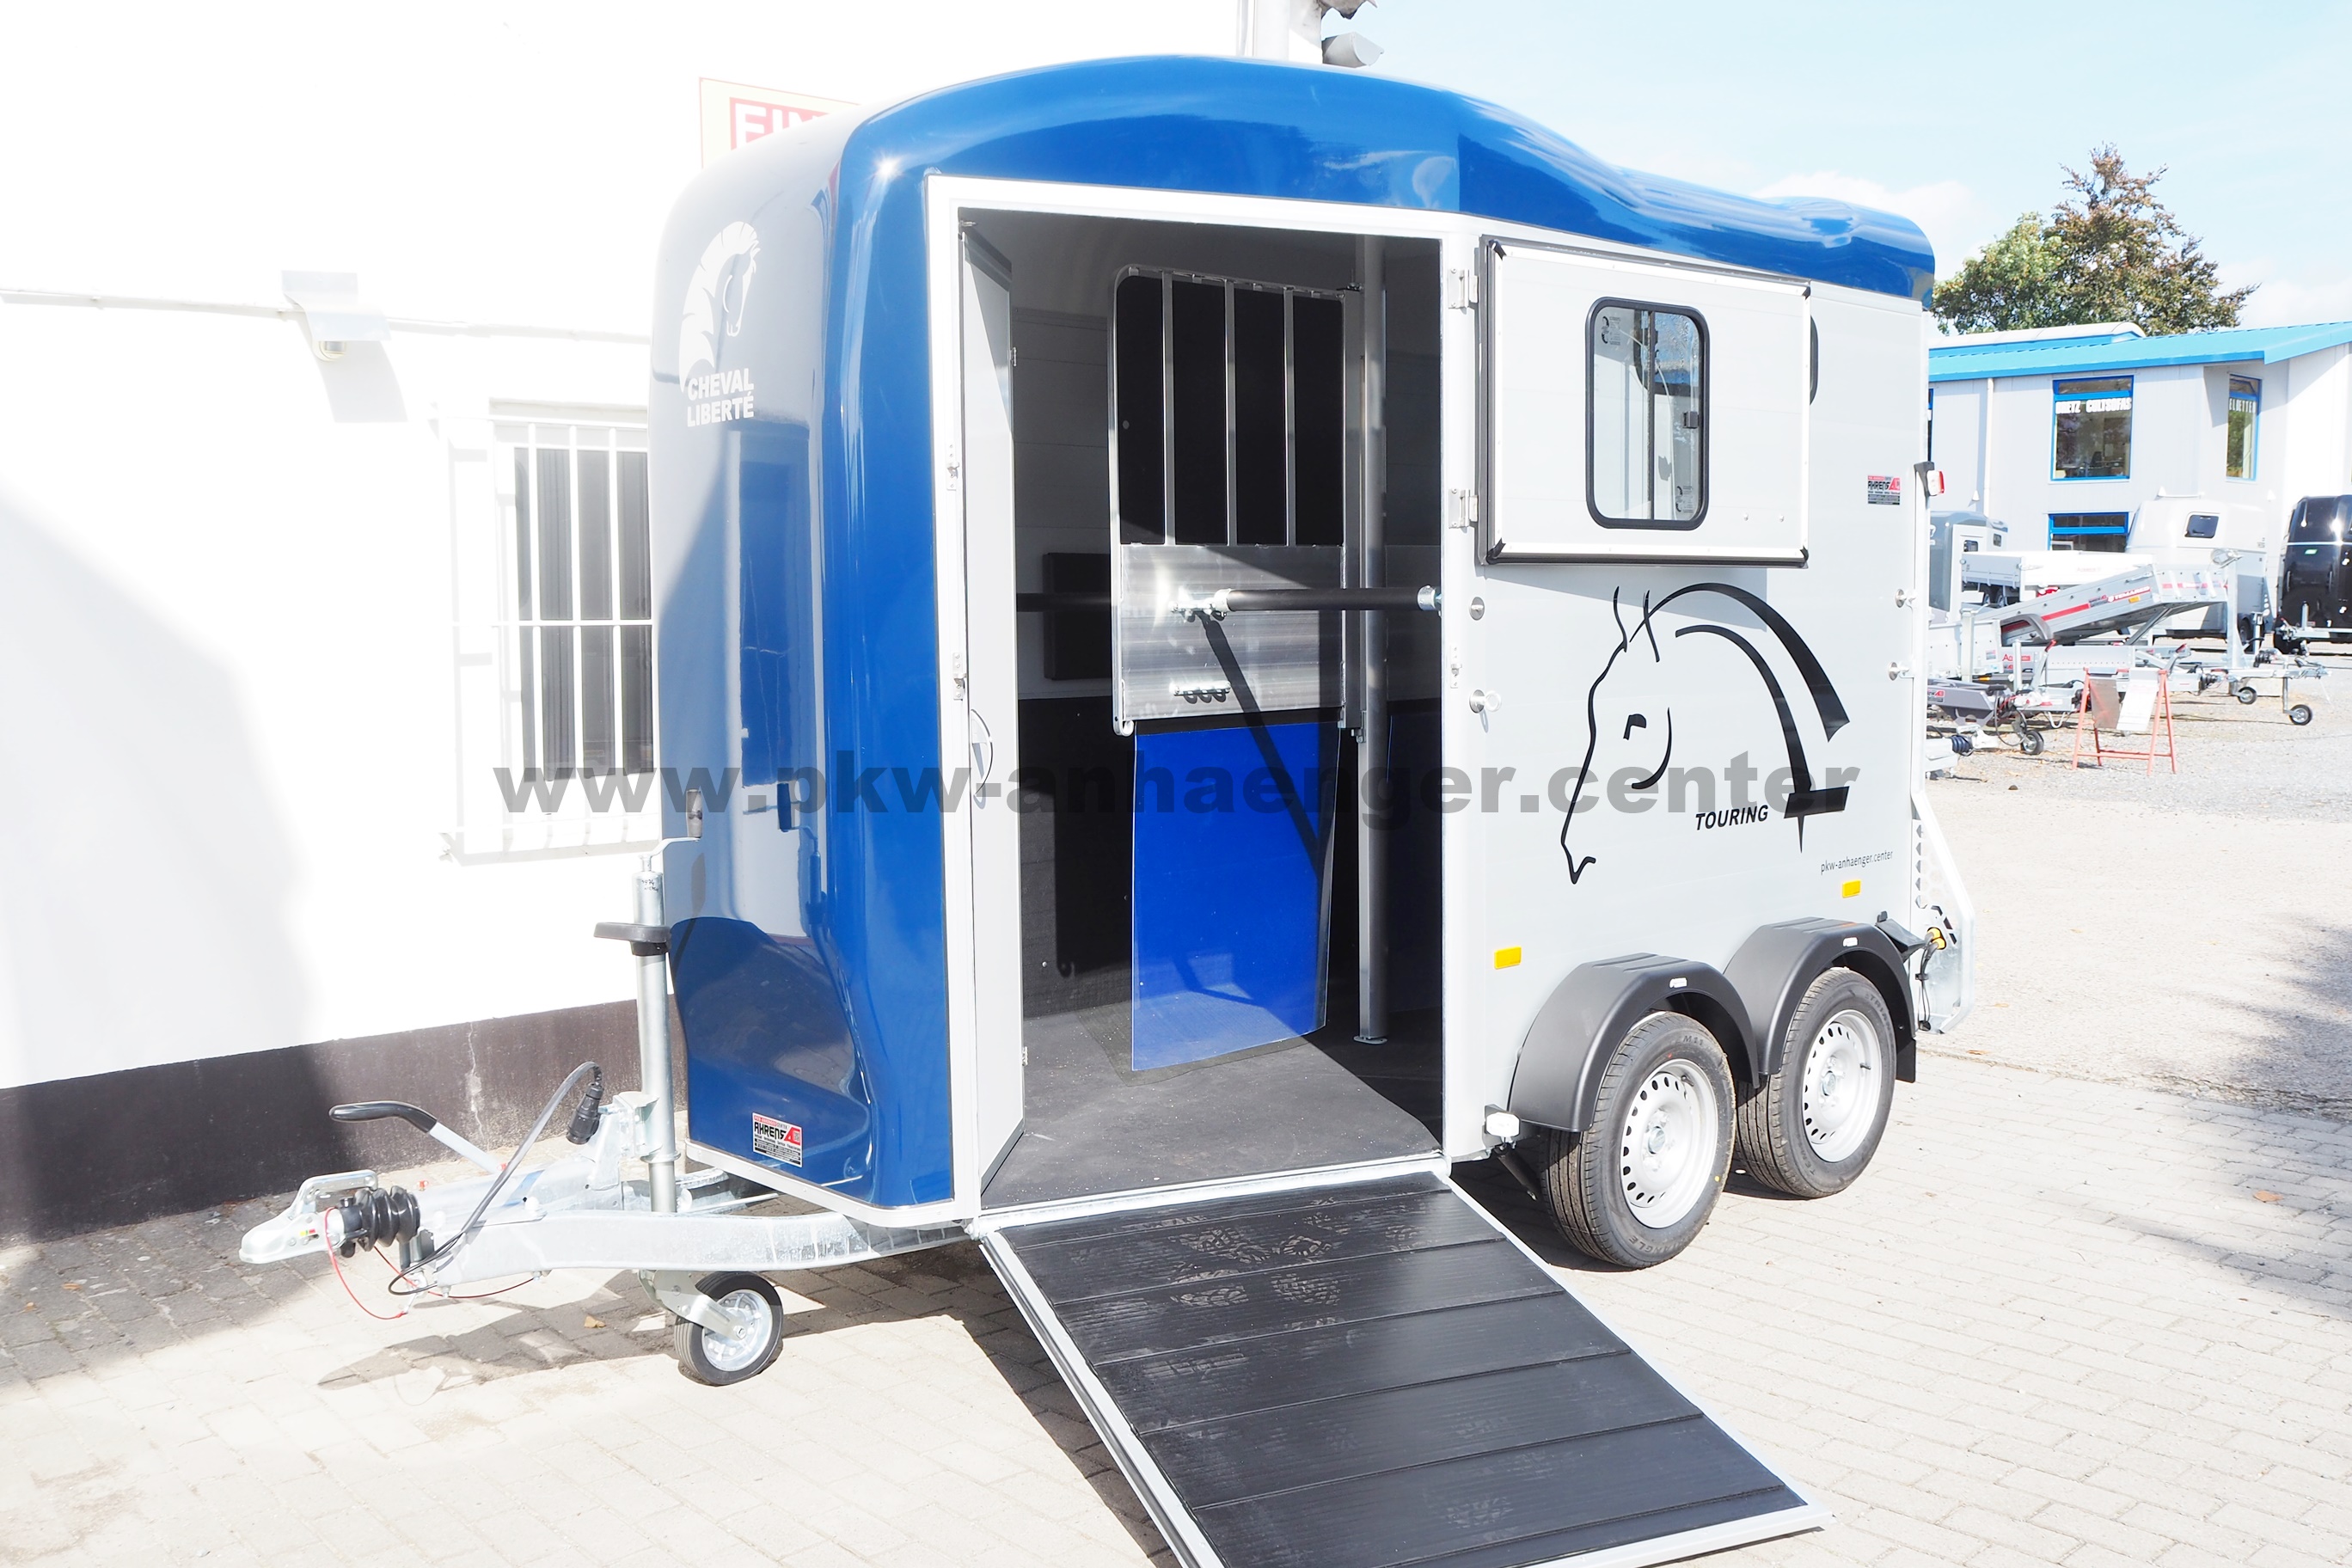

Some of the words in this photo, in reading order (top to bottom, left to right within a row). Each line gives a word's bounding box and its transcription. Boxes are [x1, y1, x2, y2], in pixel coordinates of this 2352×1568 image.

[688, 368, 754, 401] CHEVAL
[688, 391, 754, 427] LIBERTÉ
[1695, 805, 1768, 830] TOURING
[1821, 850, 1893, 875] pkw-anhaenger.center
[754, 1122, 787, 1140] AHRENS
